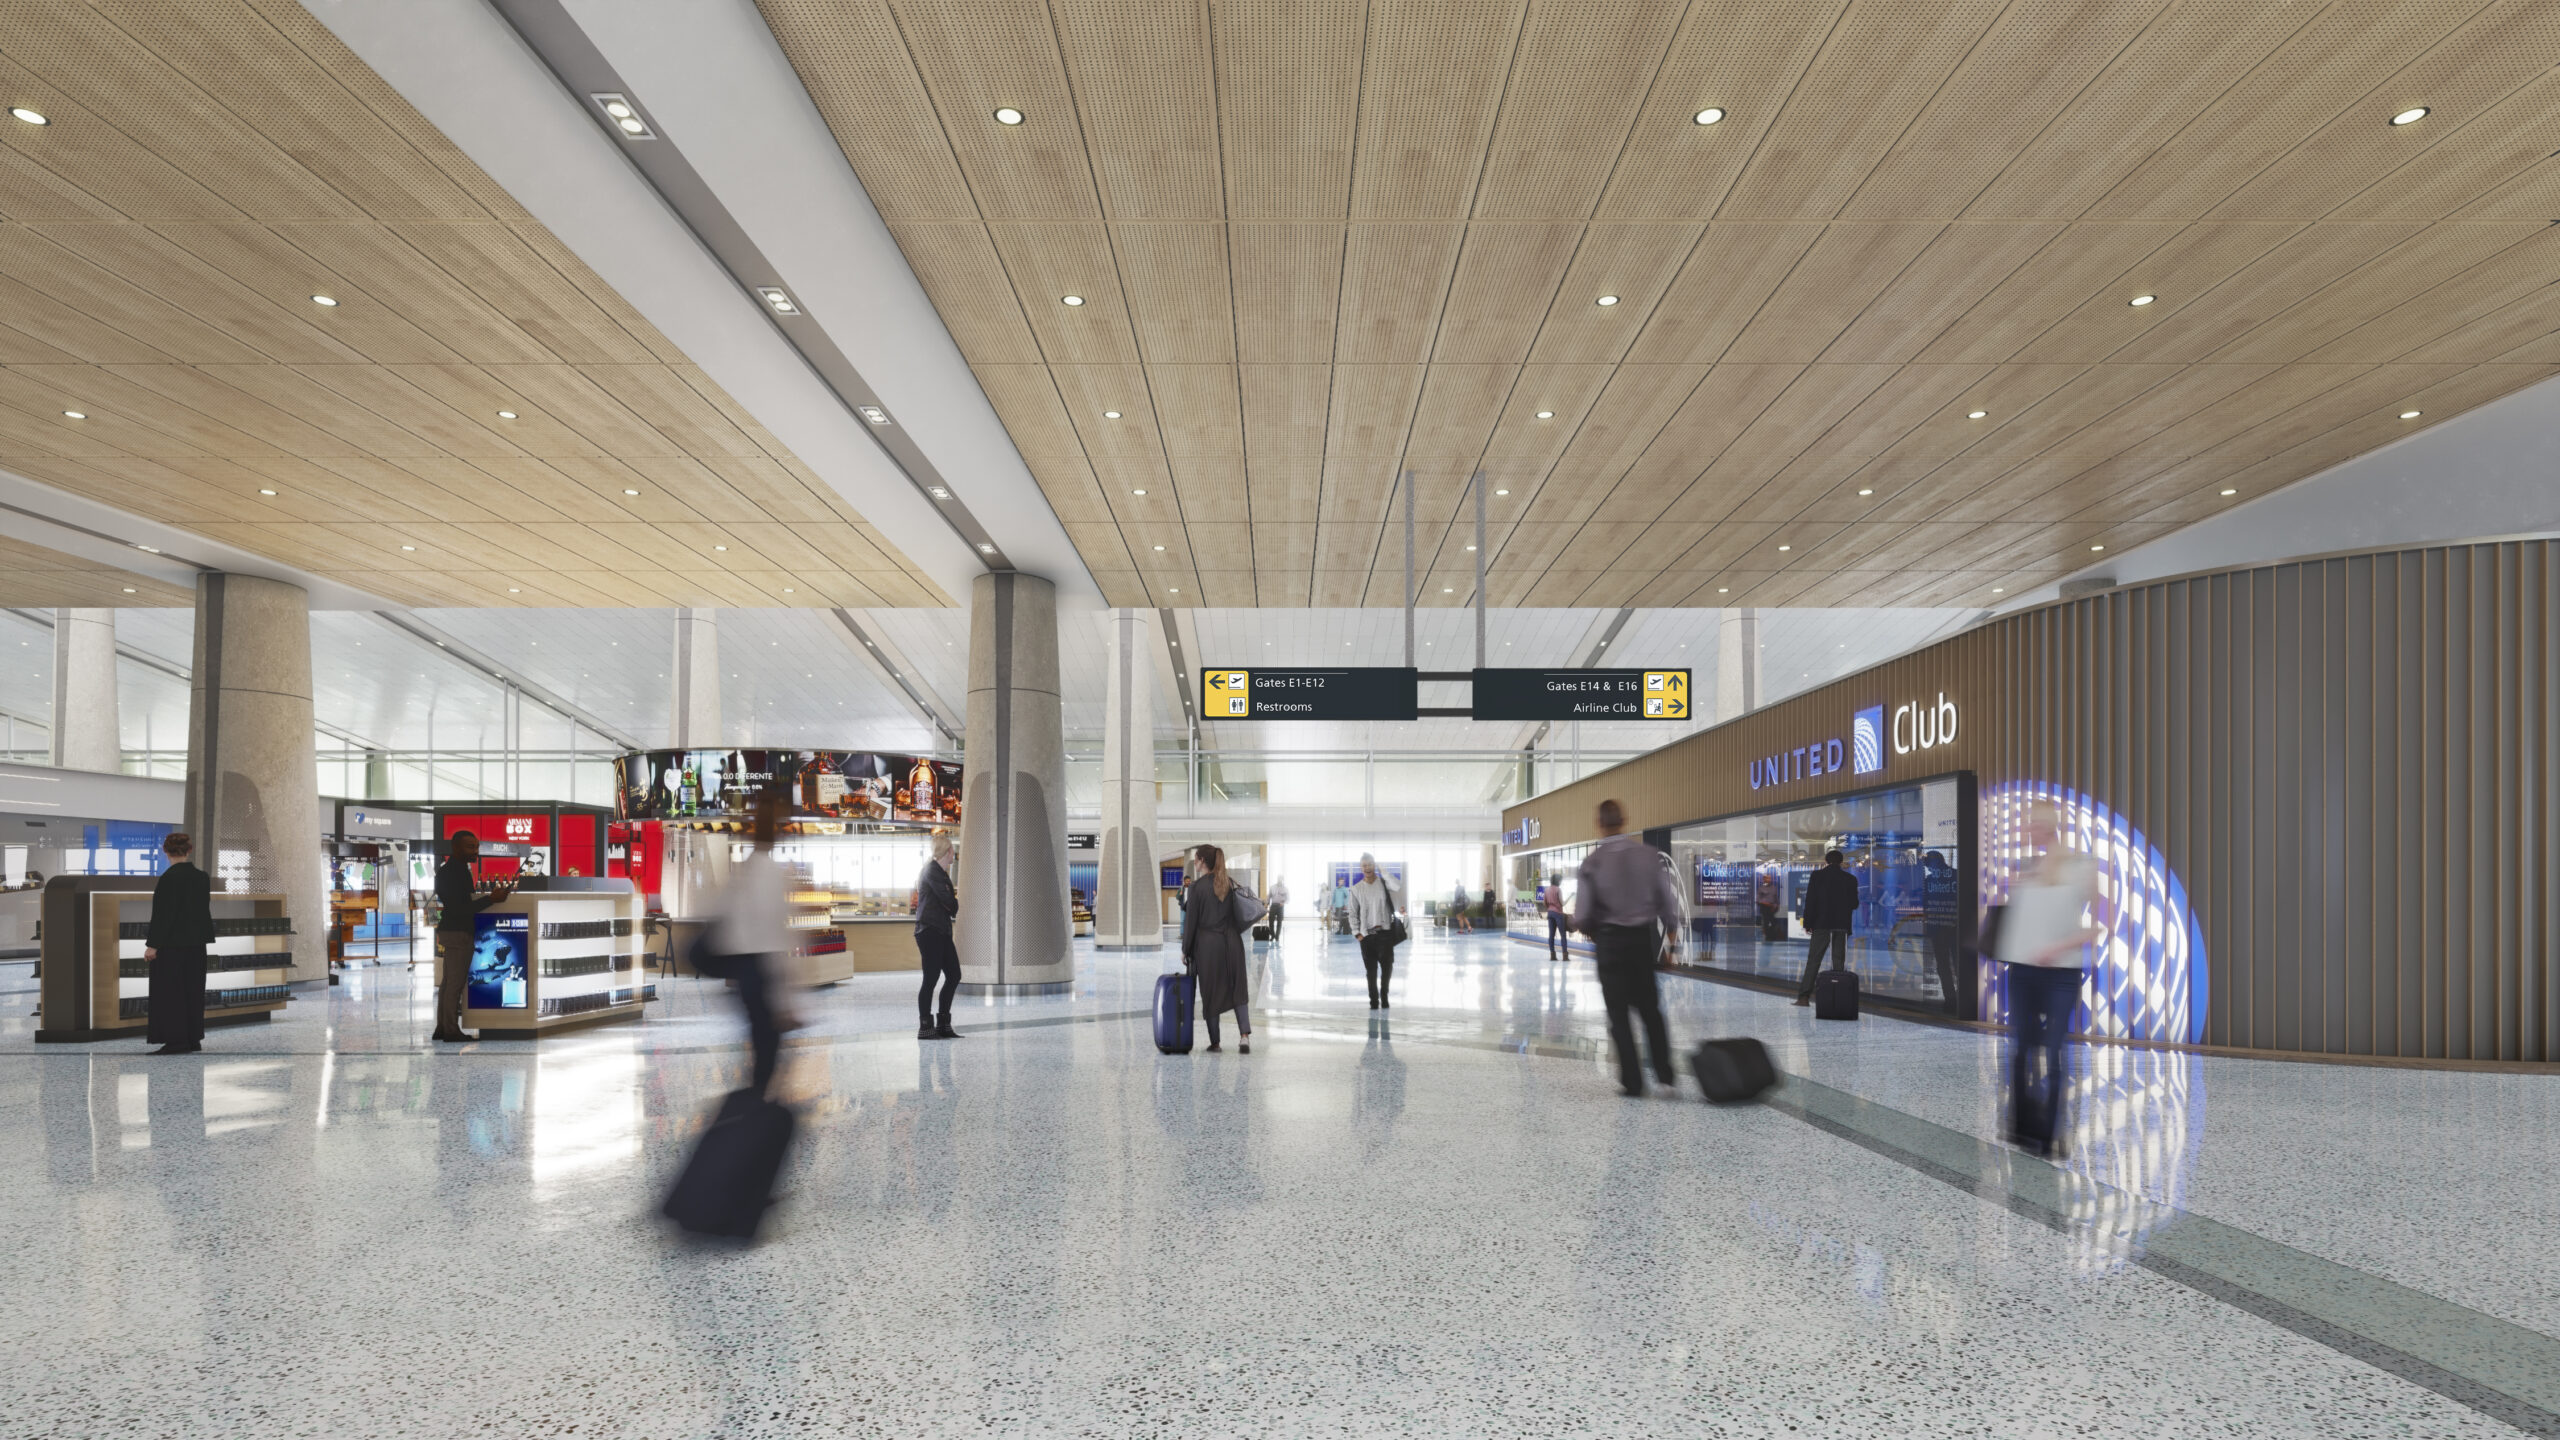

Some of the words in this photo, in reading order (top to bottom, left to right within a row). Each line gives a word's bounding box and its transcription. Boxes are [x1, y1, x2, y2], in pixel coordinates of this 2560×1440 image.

[1255, 678, 1286, 688] Gates
[1289, 678, 1325, 688] E1-E12
[1546, 681, 1577, 691] Gates
[1580, 681, 1600, 691] E14
[1603, 681, 1611, 691] &
[1618, 681, 1638, 691] E16
[1256, 702, 1313, 712] Restrooms
[1573, 702, 1610, 713] Airline
[1612, 702, 1638, 713] Club
[1750, 737, 1845, 790] UNITED
[1893, 692, 1957, 754] Club
[735, 772, 773, 780] DFERENTE
[506, 825, 533, 834] BOX
[1529, 816, 1541, 840] Club
[1703, 868, 1735, 878] United
